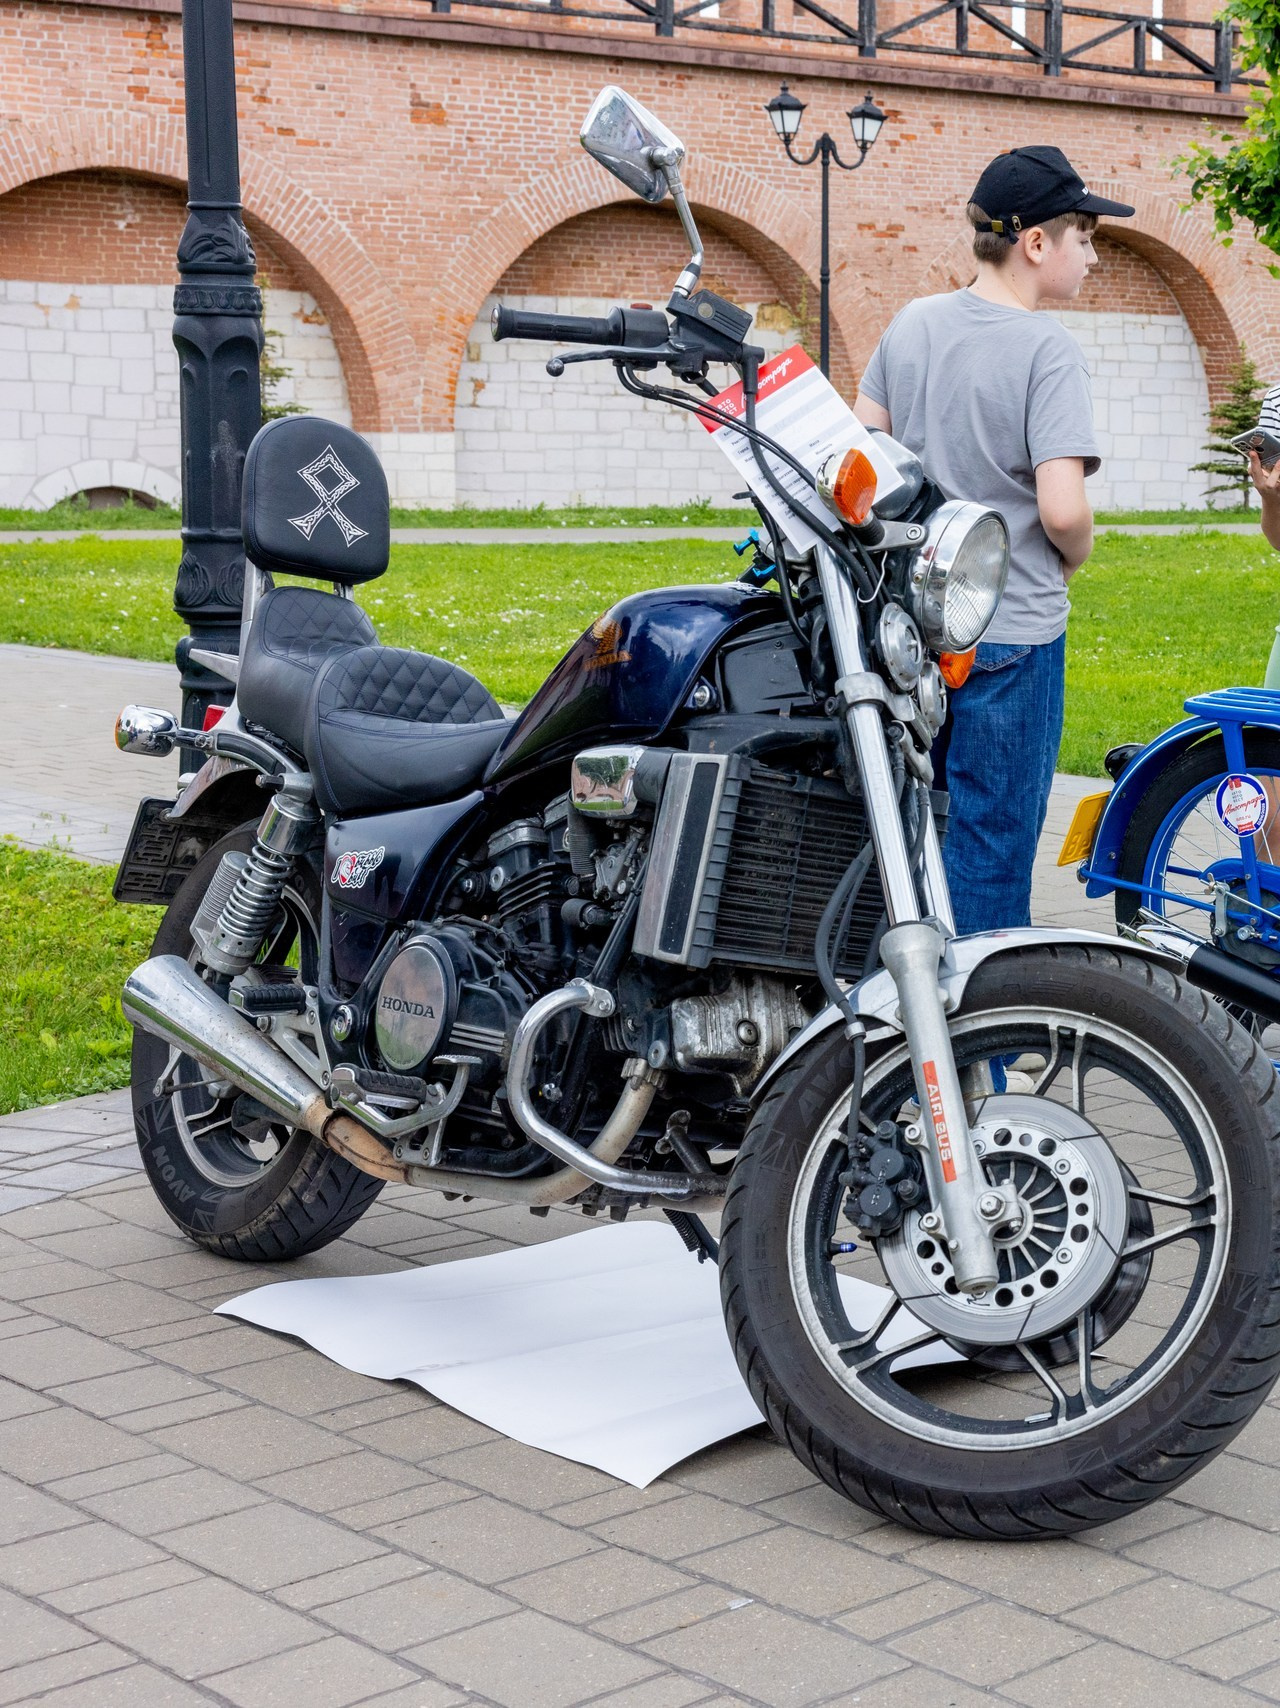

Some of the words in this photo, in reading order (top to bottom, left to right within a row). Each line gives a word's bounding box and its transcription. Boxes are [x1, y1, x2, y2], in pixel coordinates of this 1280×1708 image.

[583, 650, 632, 672] HONDA
[381, 996, 436, 1020] HONDA
[927, 1083, 943, 1117] AIR
[935, 1121, 953, 1161] SUS
[151, 1145, 197, 1203] AVON
